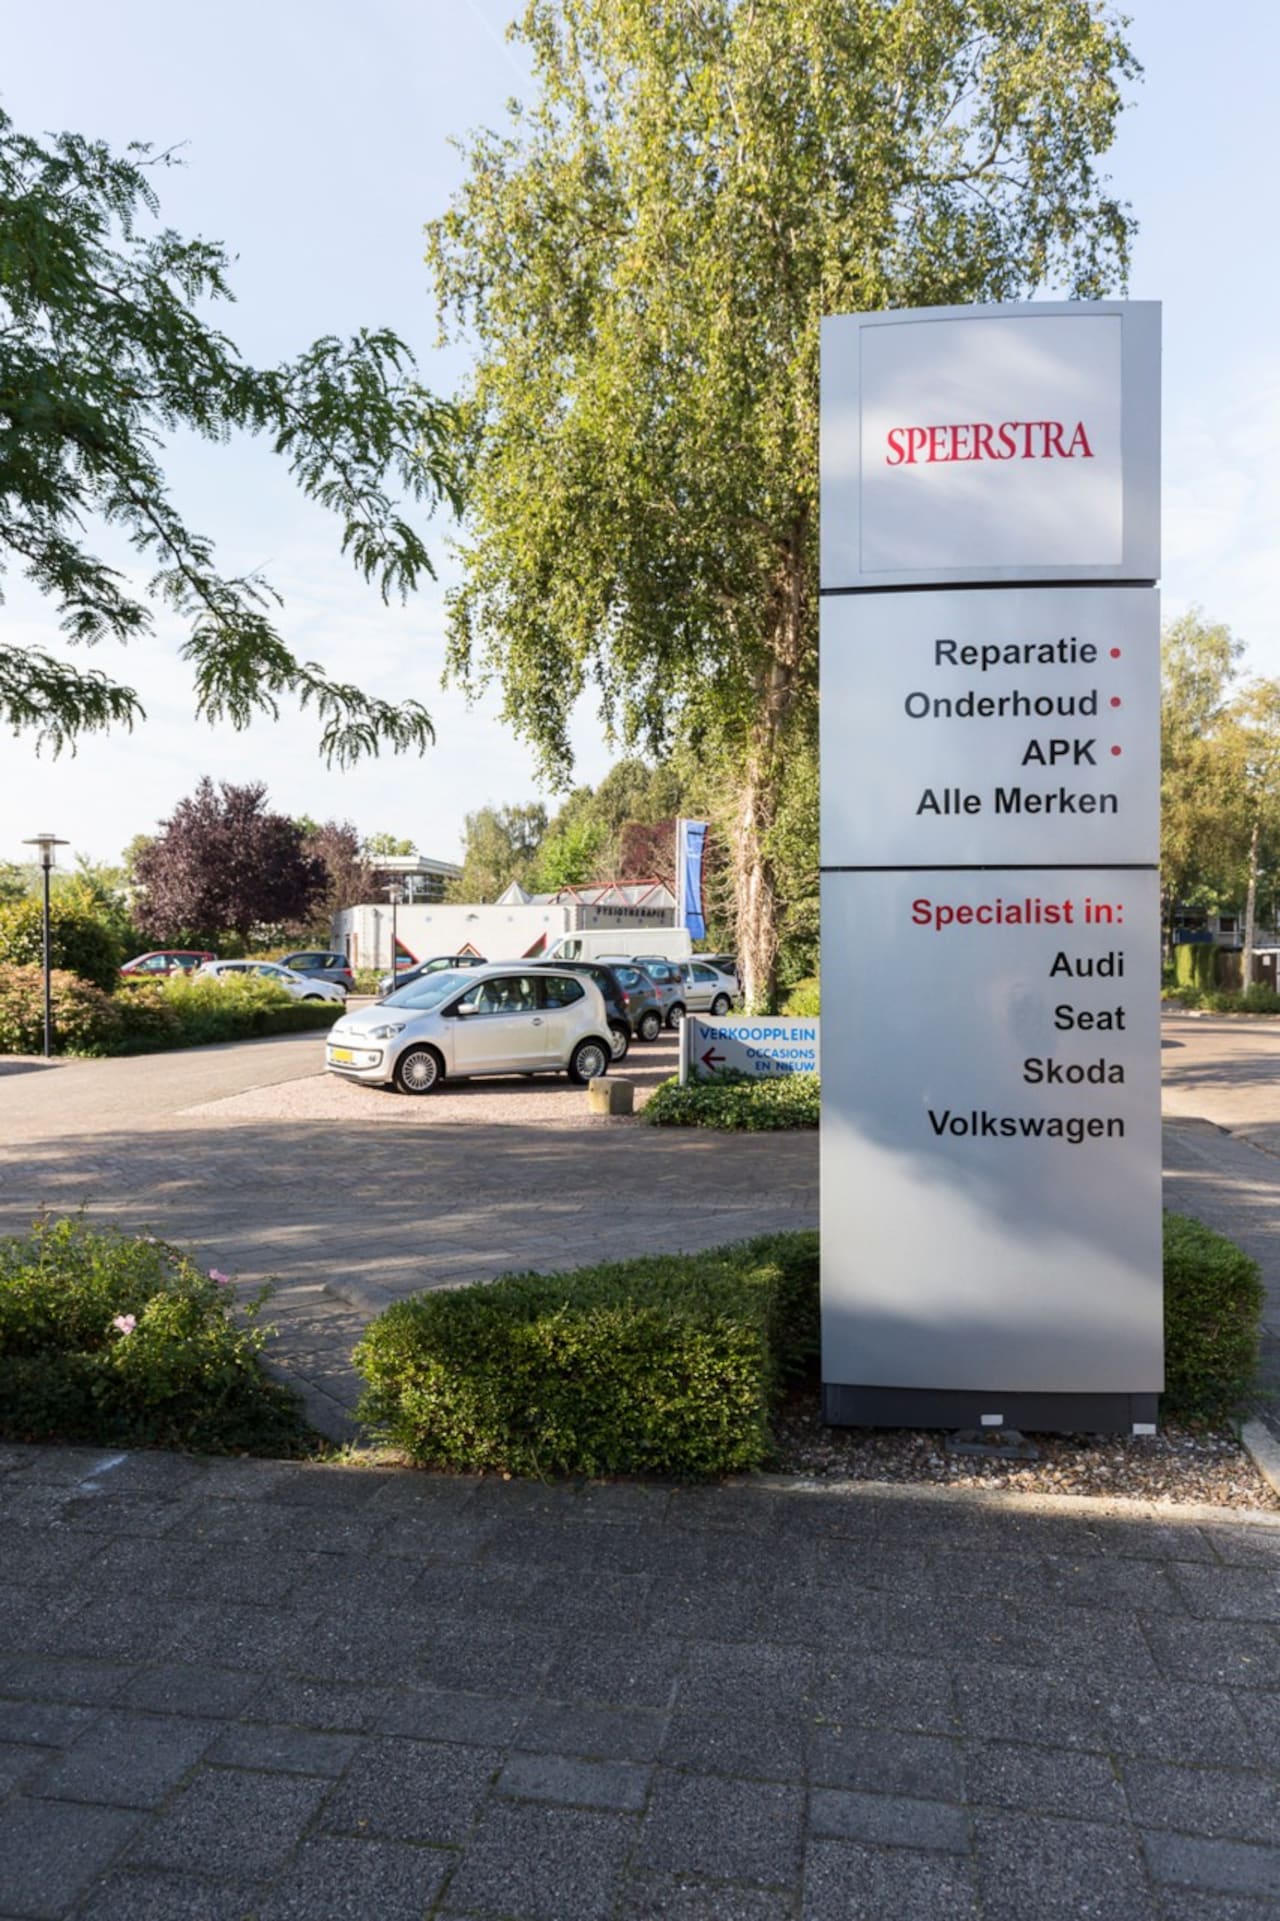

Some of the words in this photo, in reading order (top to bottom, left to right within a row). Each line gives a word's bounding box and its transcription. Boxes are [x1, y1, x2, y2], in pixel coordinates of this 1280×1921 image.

[886, 420, 1095, 465] SPEERSTRA
[935, 637, 1098, 671] Reparatie
[904, 689, 1098, 719] Onderhoud
[1021, 739, 1098, 766] APK
[916, 788, 981, 815] Alle
[995, 787, 1118, 814] Merken
[911, 898, 1074, 931] Specialist
[1084, 898, 1124, 924] in:
[1049, 951, 1124, 977] Audi
[1054, 1005, 1125, 1031] Seat
[699, 1027, 815, 1041] VERKOOPPLEIN
[746, 1048, 815, 1059] OCCASIONS
[755, 1061, 771, 1071] EN
[775, 1061, 815, 1072] NIEUW
[1023, 1057, 1125, 1084] Skoda
[928, 1110, 1125, 1144] Volkswagen
